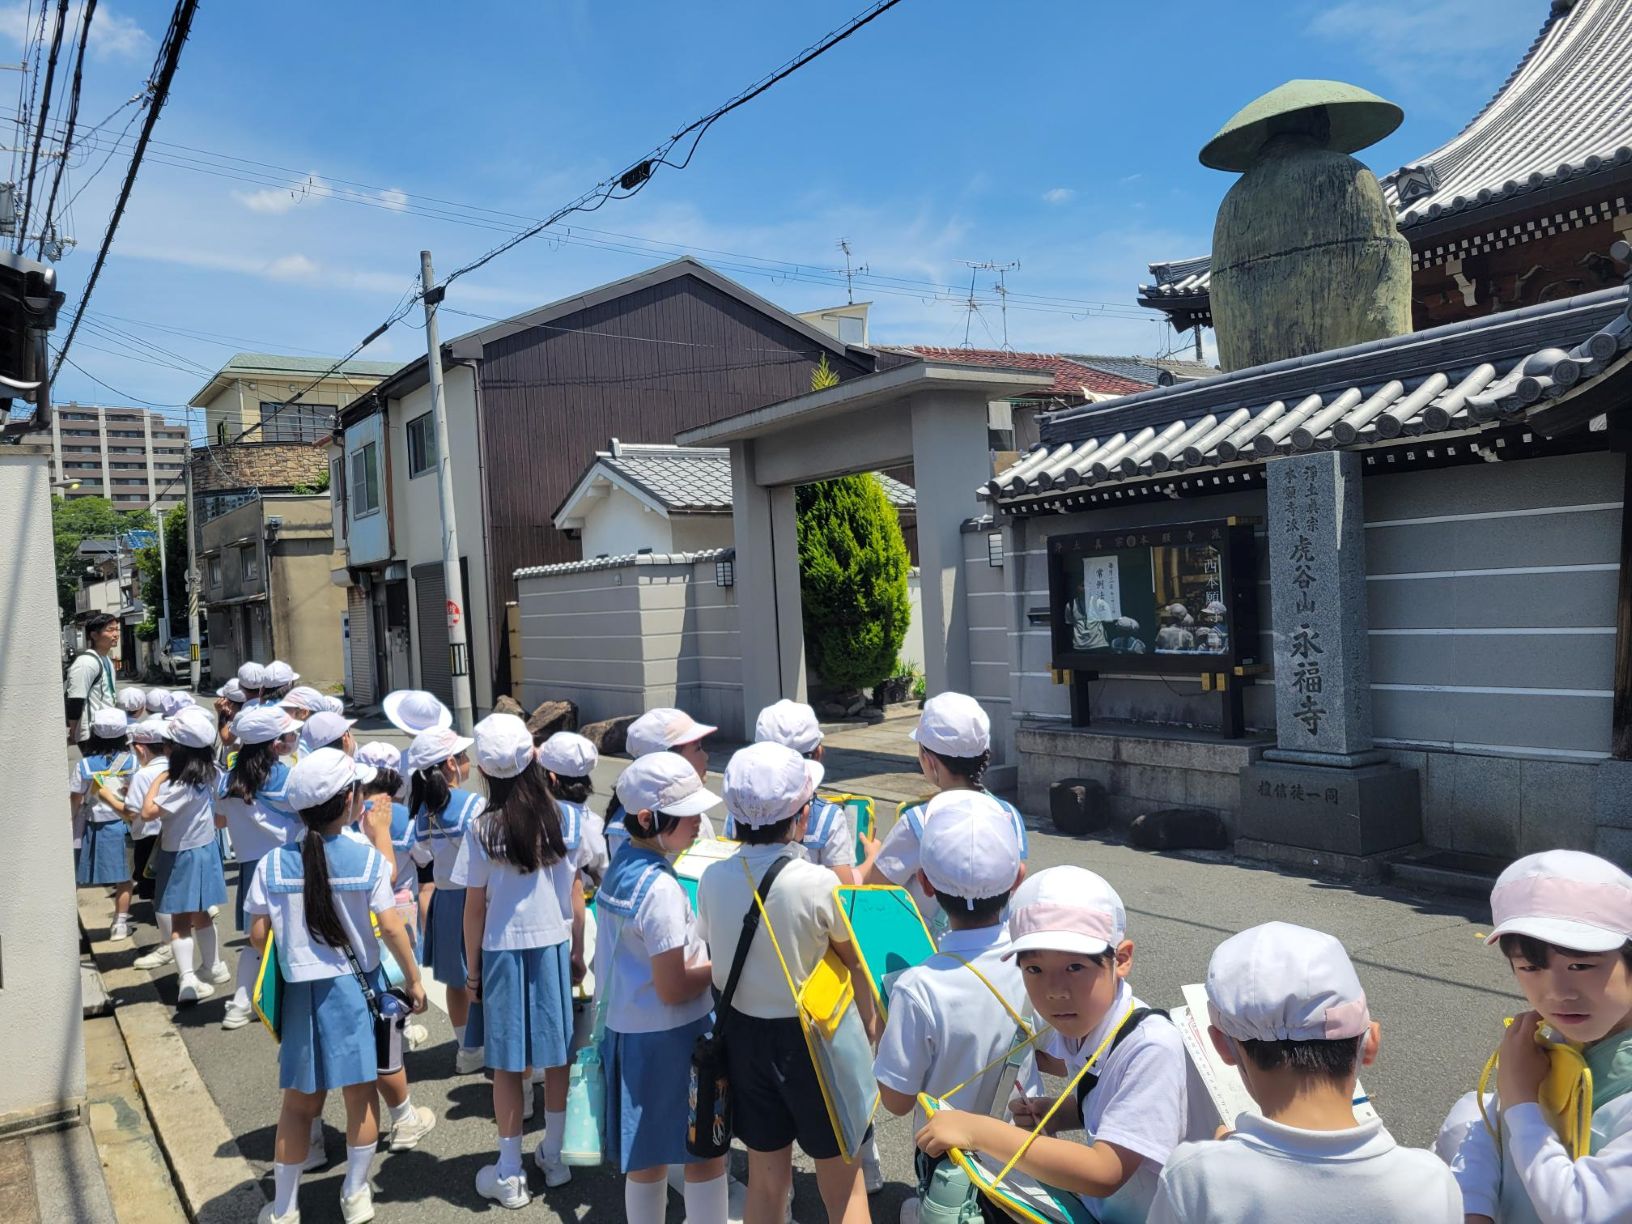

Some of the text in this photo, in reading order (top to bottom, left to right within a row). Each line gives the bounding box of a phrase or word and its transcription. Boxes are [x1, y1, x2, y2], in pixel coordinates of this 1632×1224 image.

[1289, 534, 1327, 736] 虎谷山 永福寺
